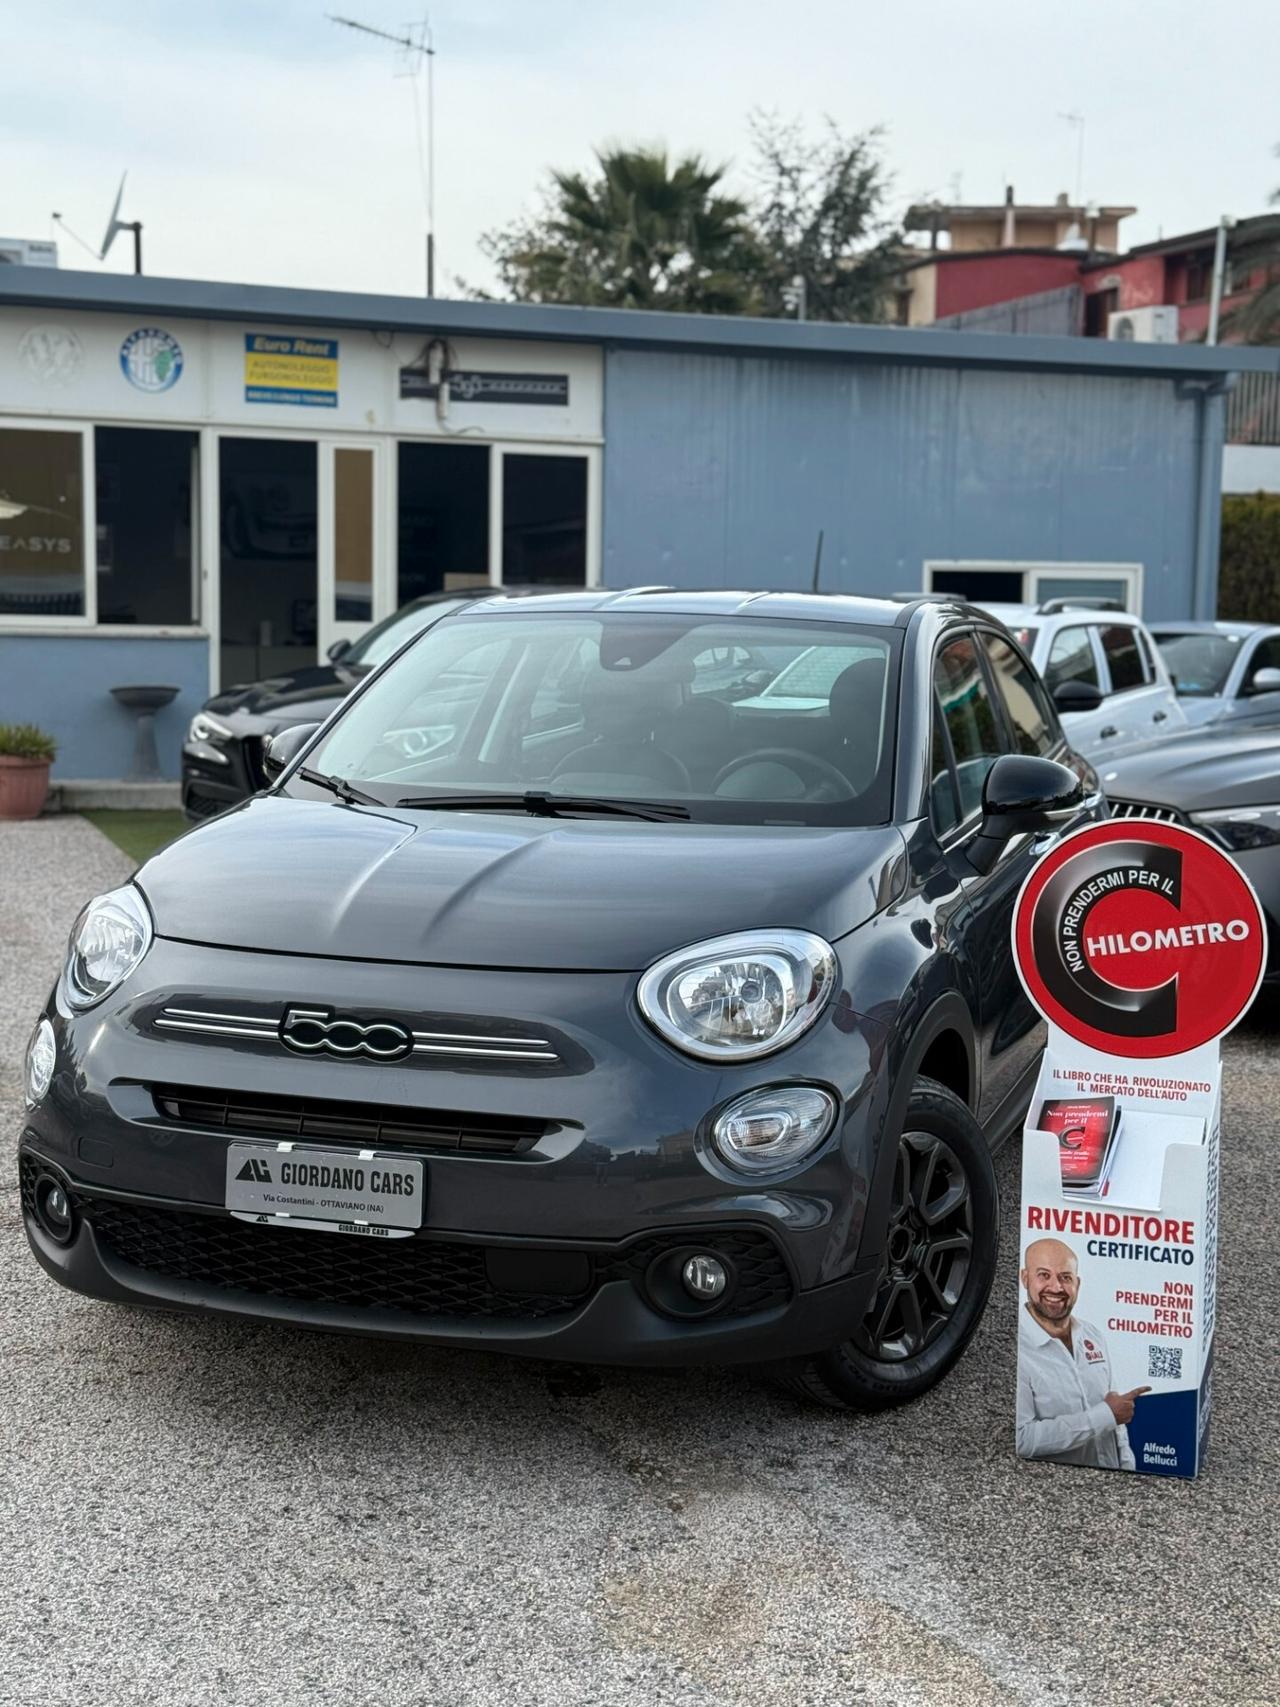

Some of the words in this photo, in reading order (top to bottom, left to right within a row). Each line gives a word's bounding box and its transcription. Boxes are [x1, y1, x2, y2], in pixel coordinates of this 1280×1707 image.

[254, 337, 290, 352] Euro
[295, 340, 330, 355] Rent
[1129, 870, 1160, 887] PER
[1161, 879, 1174, 895] IL
[1063, 871, 1125, 936] PRENDERMI
[1087, 919, 1249, 957] HILOMETRO
[1063, 940, 1084, 973] NON
[281, 1005, 410, 1058] 500
[1053, 1069, 1062, 1079] IL
[1063, 1070, 1092, 1082] LIBRO
[1093, 1073, 1113, 1084] CHE
[1114, 1074, 1128, 1085] HA
[1133, 1076, 1211, 1093] RIVOLUZIONATO
[1077, 1082, 1086, 1092] IL
[1090, 1083, 1136, 1096] MERCATO
[281, 1162, 365, 1192] GIORDANO
[370, 1171, 415, 1197] CARS
[263, 1194, 275, 1203] Via
[276, 1195, 315, 1206] Costantini
[320, 1199, 366, 1211] OTTAVIANO
[366, 1203, 385, 1214] (NA)
[338, 1224, 371, 1235] GIORDANO
[372, 1227, 389, 1237] CARS
[1027, 1206, 1195, 1245] RIVENDITORE
[1087, 1239, 1194, 1266] CERTIFICATO
[1164, 1281, 1194, 1297] NON
[1115, 1290, 1194, 1310] PRENDERMI
[1154, 1309, 1178, 1323] PER
[1182, 1311, 1194, 1325] IL
[1108, 1318, 1193, 1339] CHILOMETRO
[1143, 1442, 1176, 1455] Alfredo
[1143, 1454, 1178, 1467] Bellucci
